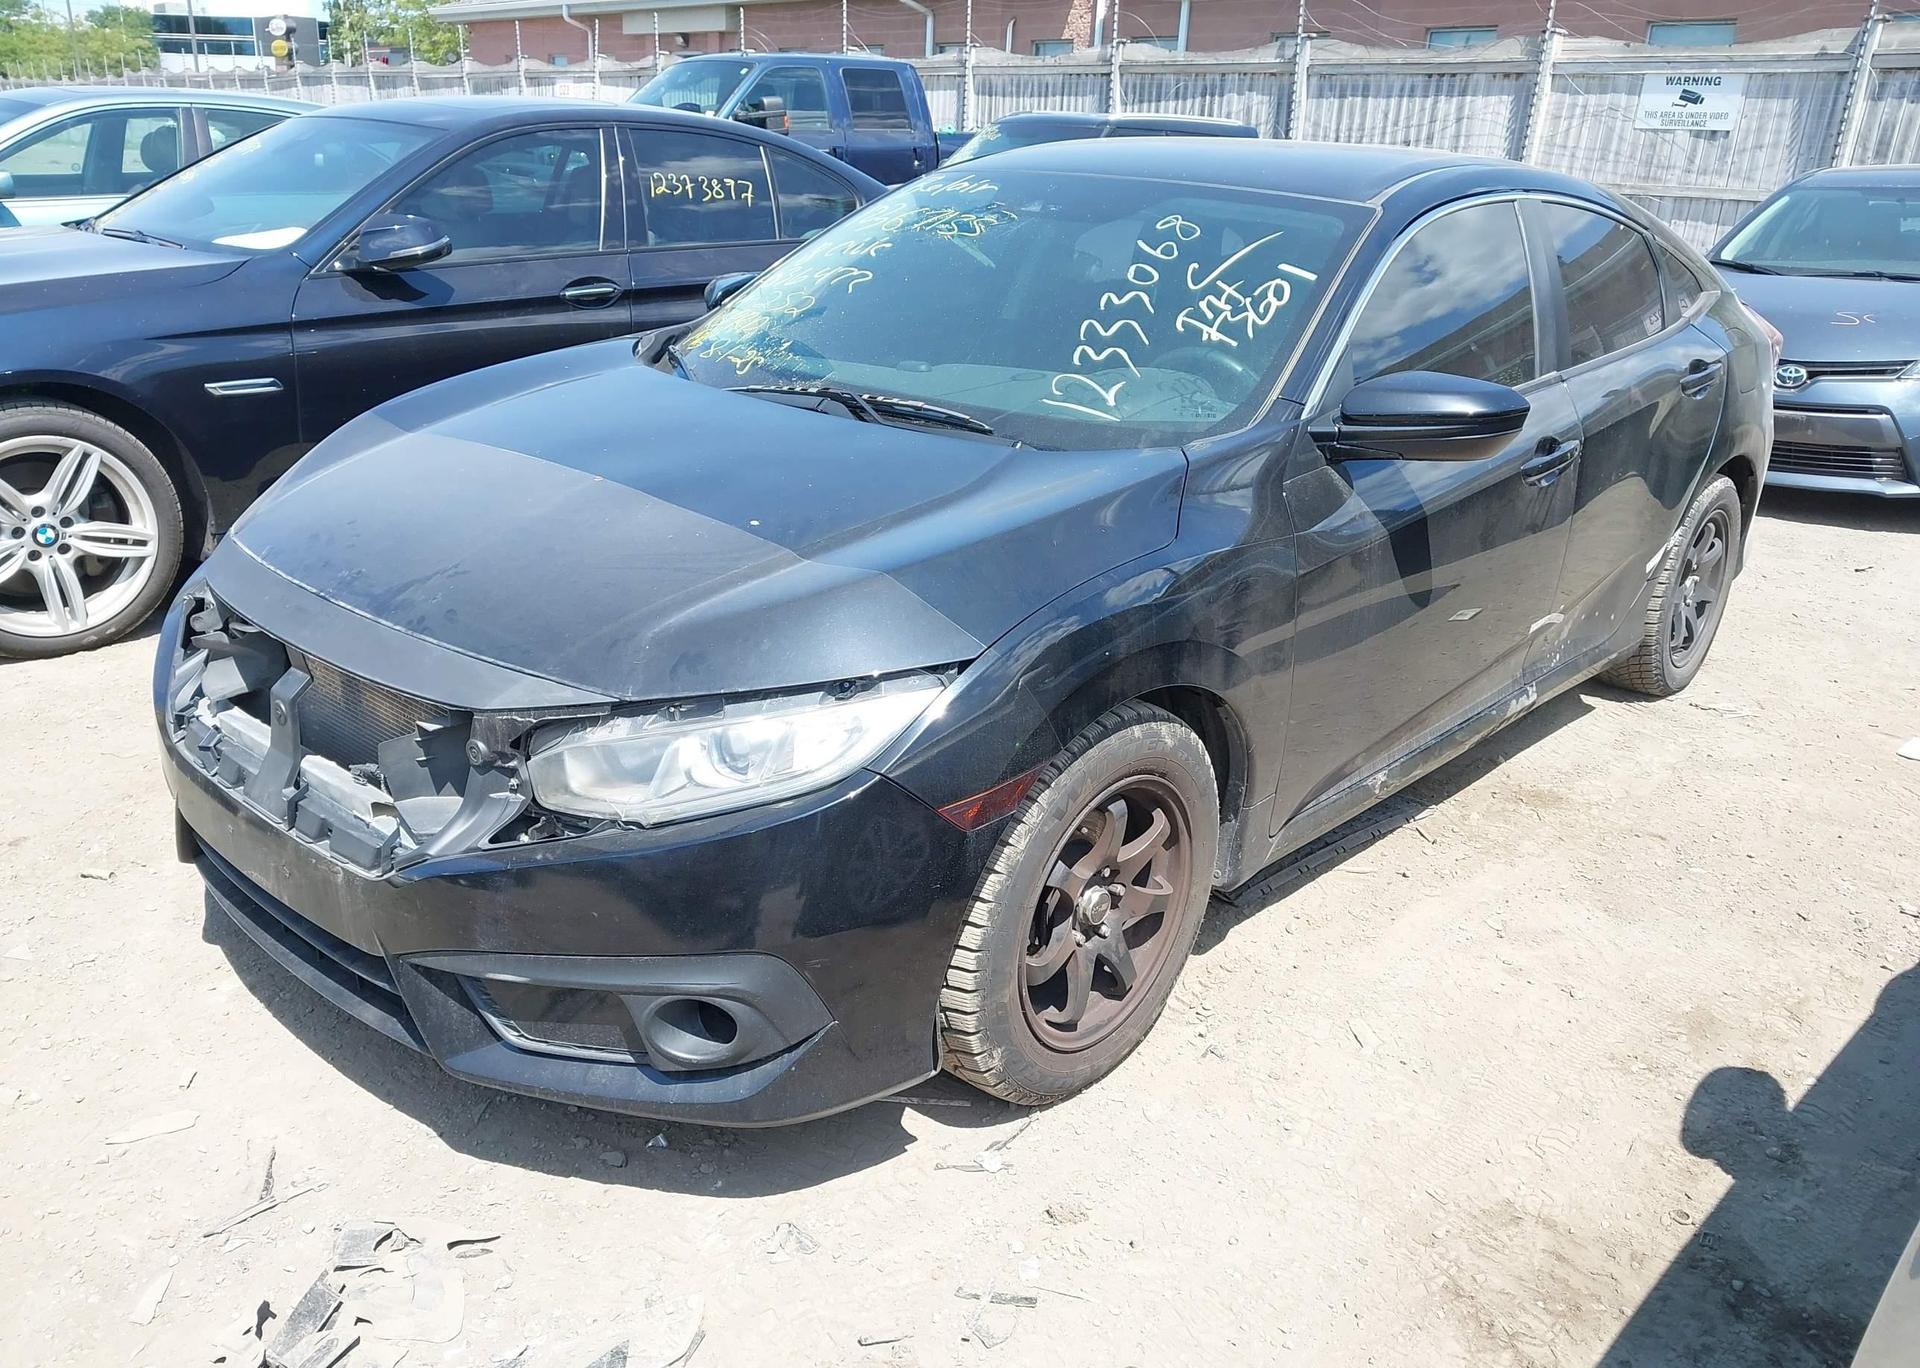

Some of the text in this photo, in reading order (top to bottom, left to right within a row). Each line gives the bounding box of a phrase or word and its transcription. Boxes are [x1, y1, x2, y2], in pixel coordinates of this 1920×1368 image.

[1665, 76, 1722, 86] WARNING
[1644, 111, 1729, 120] THIS AREA IS UNDER VIDEO
[1660, 120, 1708, 128] SURVEILLANCE
[1040, 214, 1201, 422] 12333068
